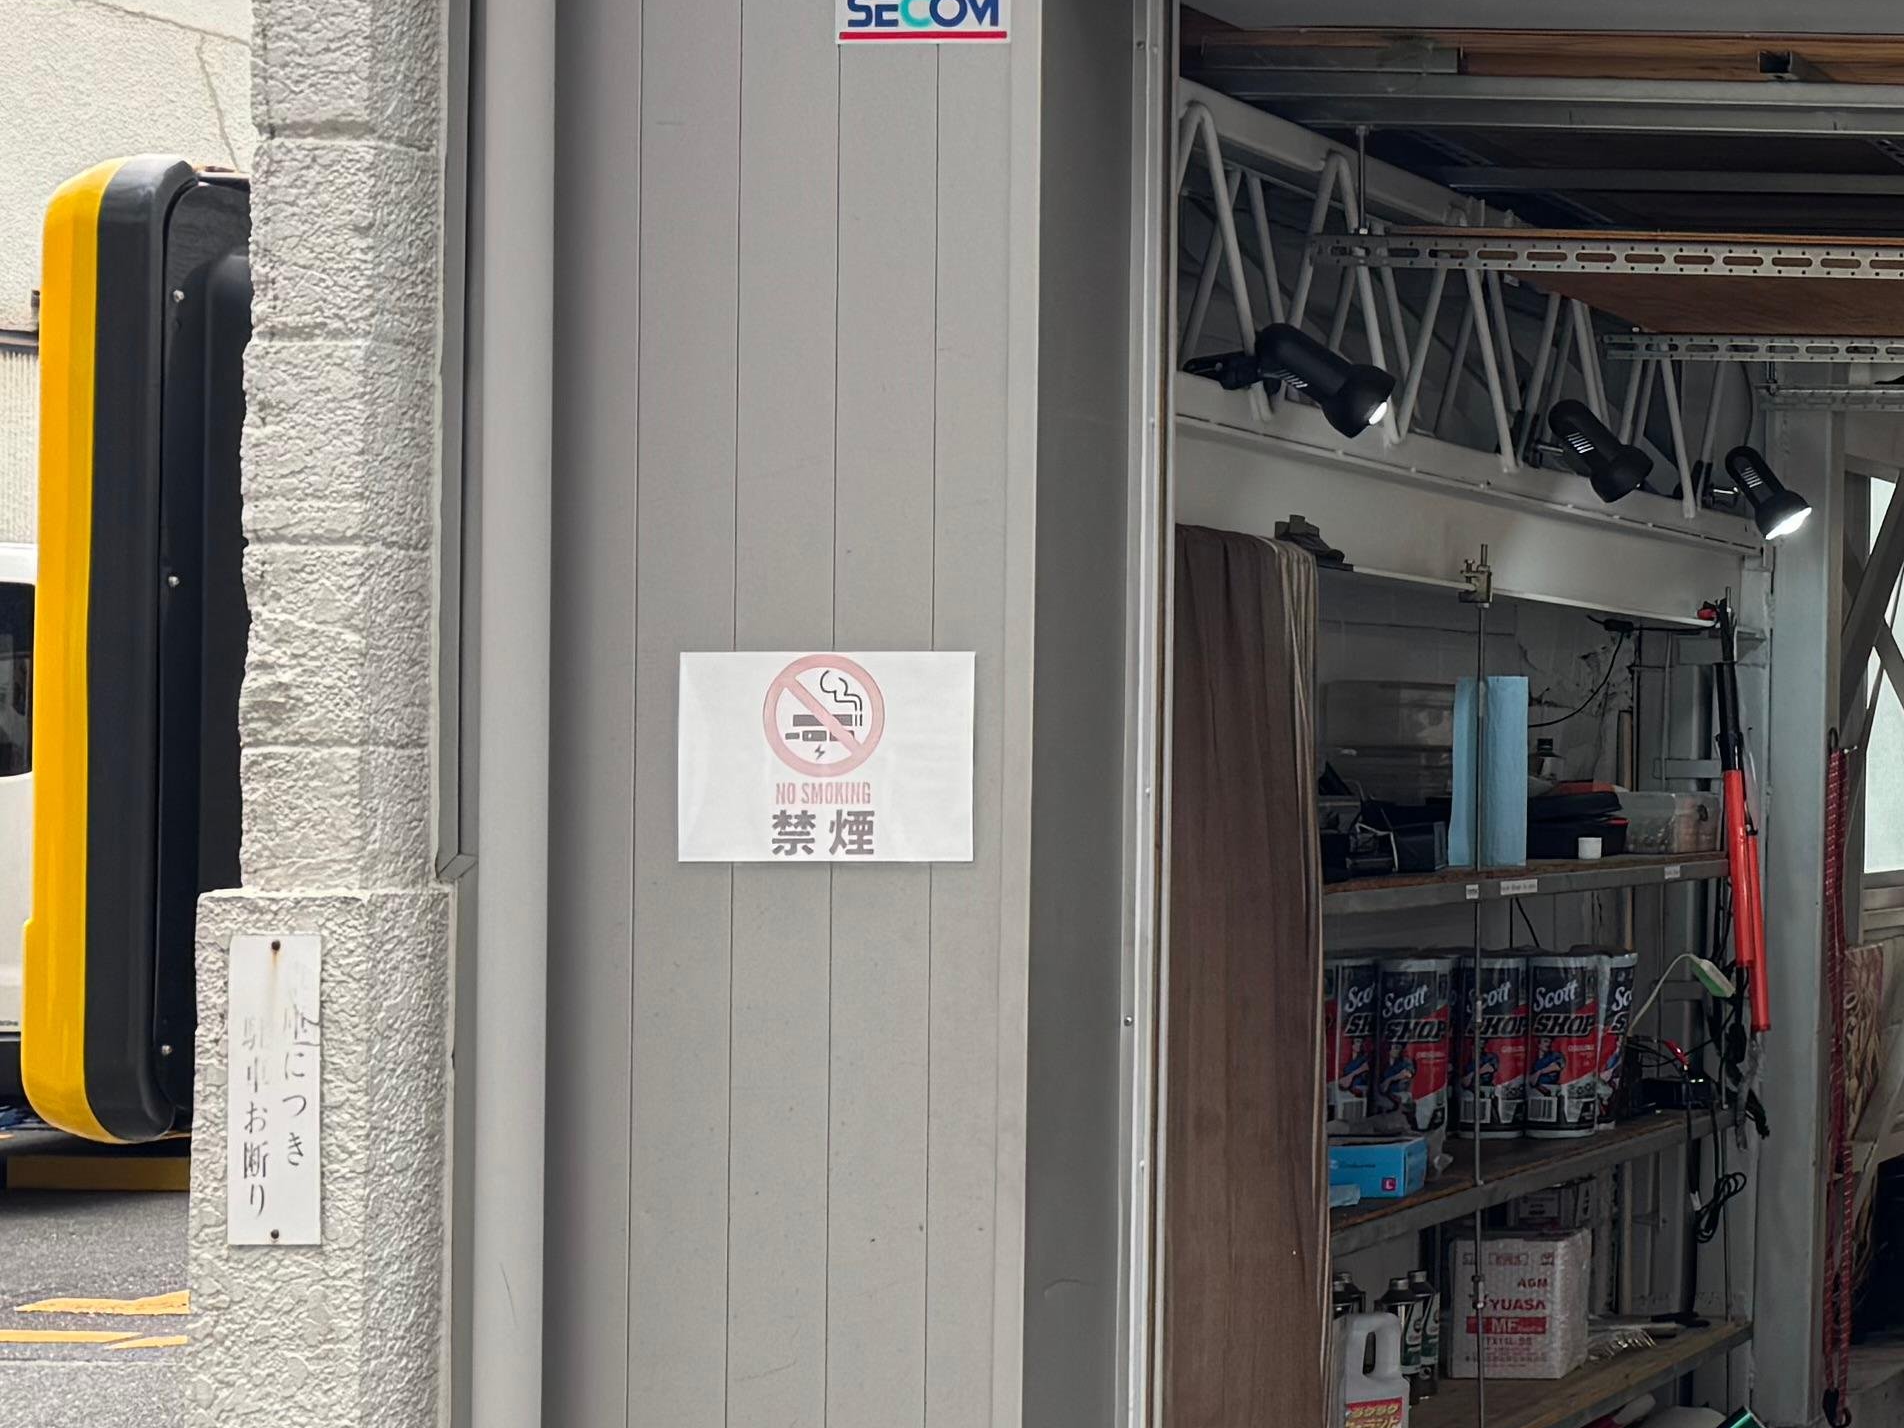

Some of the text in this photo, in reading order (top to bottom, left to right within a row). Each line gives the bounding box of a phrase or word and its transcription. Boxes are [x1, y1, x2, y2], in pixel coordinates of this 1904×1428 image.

[776, 782, 871, 805] NO SMOKING
[771, 810, 875, 856] 禁煙
[1345, 982, 1376, 1013] Sco
[1383, 984, 1428, 1018] Scott
[1533, 980, 1578, 1012] Scott
[1532, 1013, 1596, 1036] SHOP
[1490, 1298, 1546, 1310] YUASA
